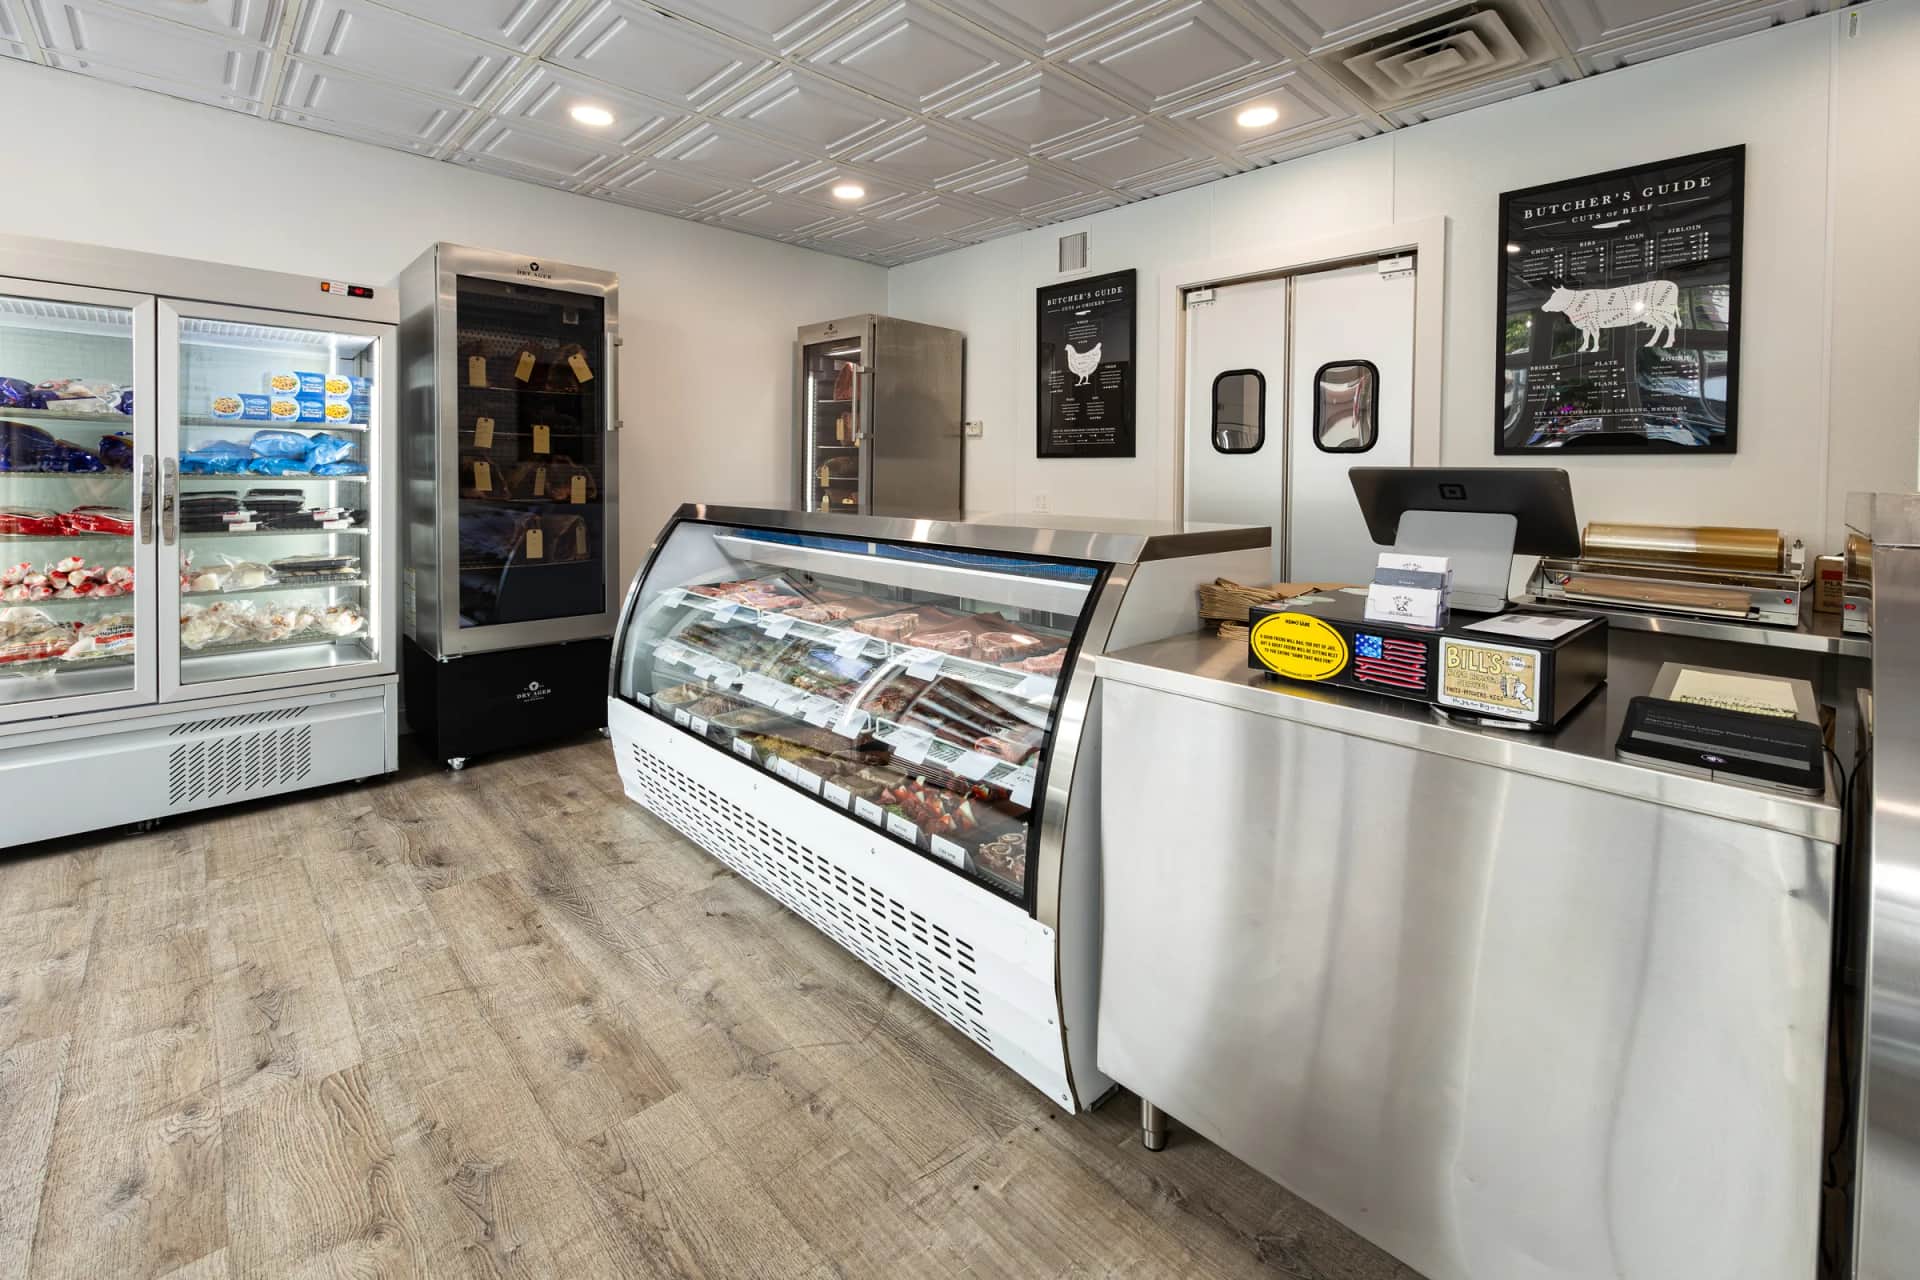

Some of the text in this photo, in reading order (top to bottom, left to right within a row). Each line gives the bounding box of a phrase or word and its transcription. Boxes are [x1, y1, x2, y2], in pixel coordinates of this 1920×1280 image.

[1524, 175, 1713, 220] BUTCHER'S GUIDE
[1571, 212, 1601, 224] CUTS
[1622, 204, 1654, 215] BEEF
[1624, 233, 1644, 241] LOIN
[1667, 224, 1702, 234] SIRLOIN
[1530, 247, 1555, 255] CHUCK
[1047, 286, 1123, 306] BUTCHER'S GUIDE
[1447, 646, 1503, 675] BILL'S
